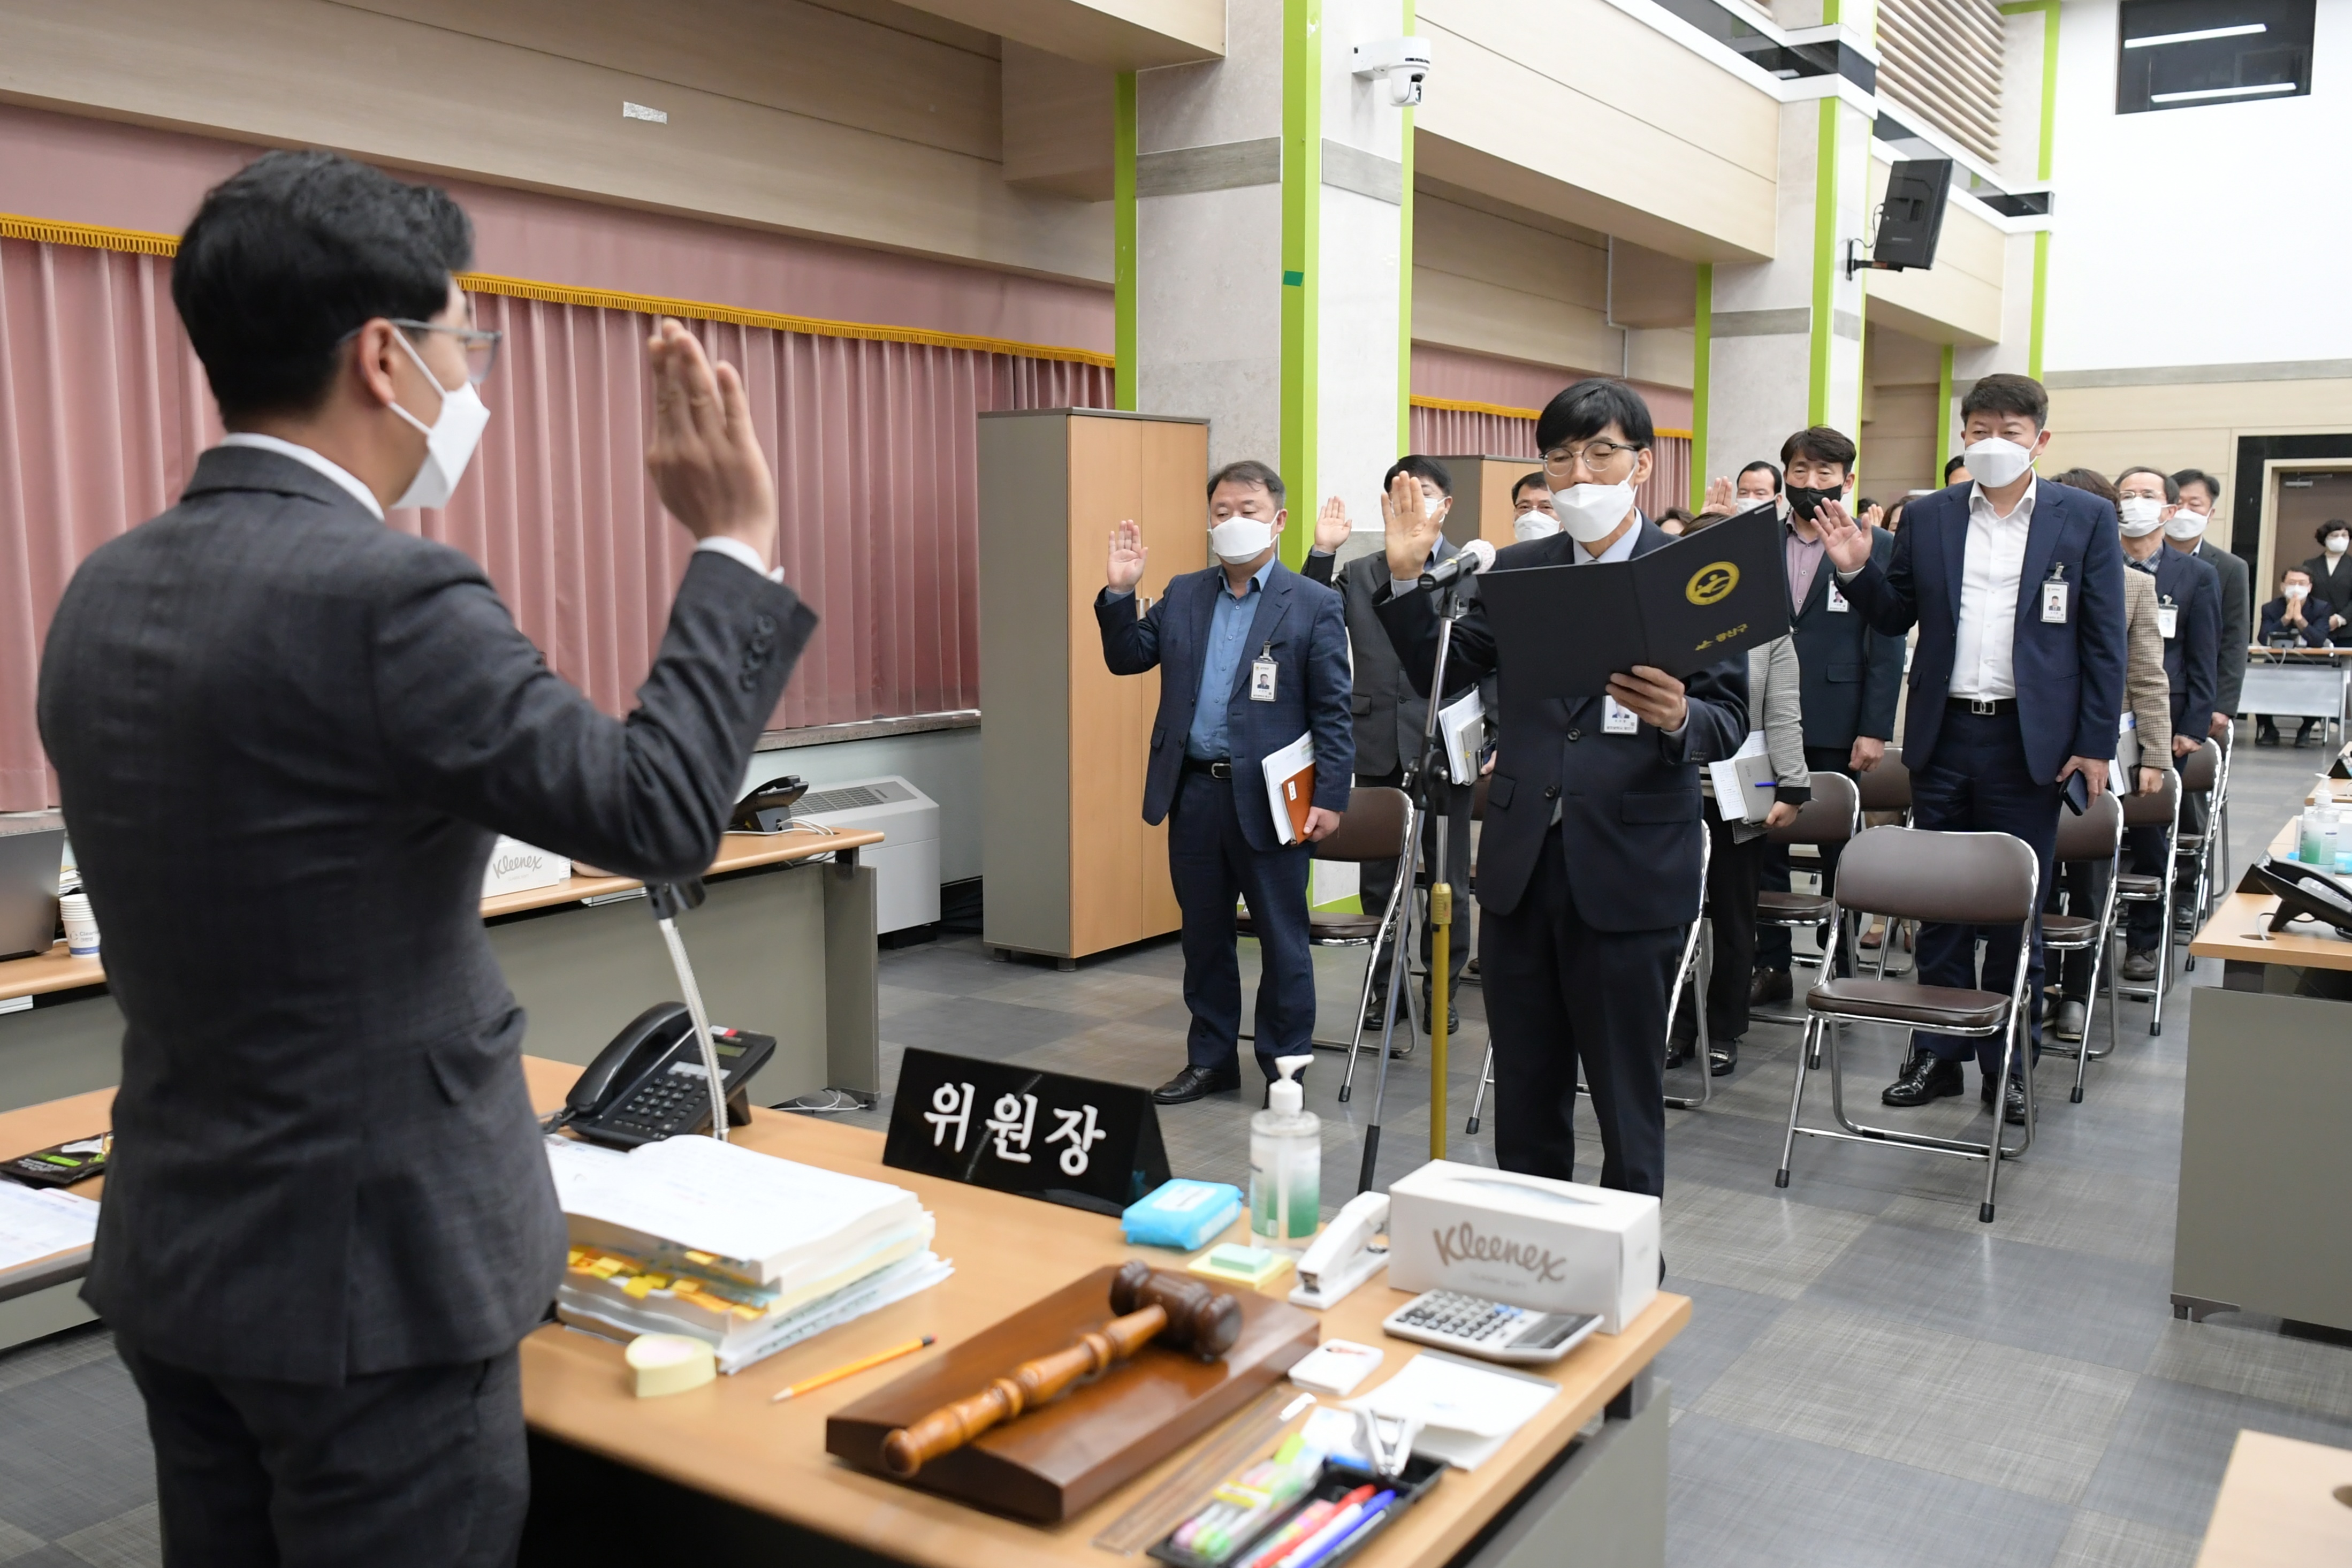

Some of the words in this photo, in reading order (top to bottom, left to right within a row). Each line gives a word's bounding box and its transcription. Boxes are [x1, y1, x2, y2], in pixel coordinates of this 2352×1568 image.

[493, 855, 542, 879] Kleenex
[924, 1082, 1106, 1176] 위원장
[1433, 1221, 1566, 1283] Kleenex
